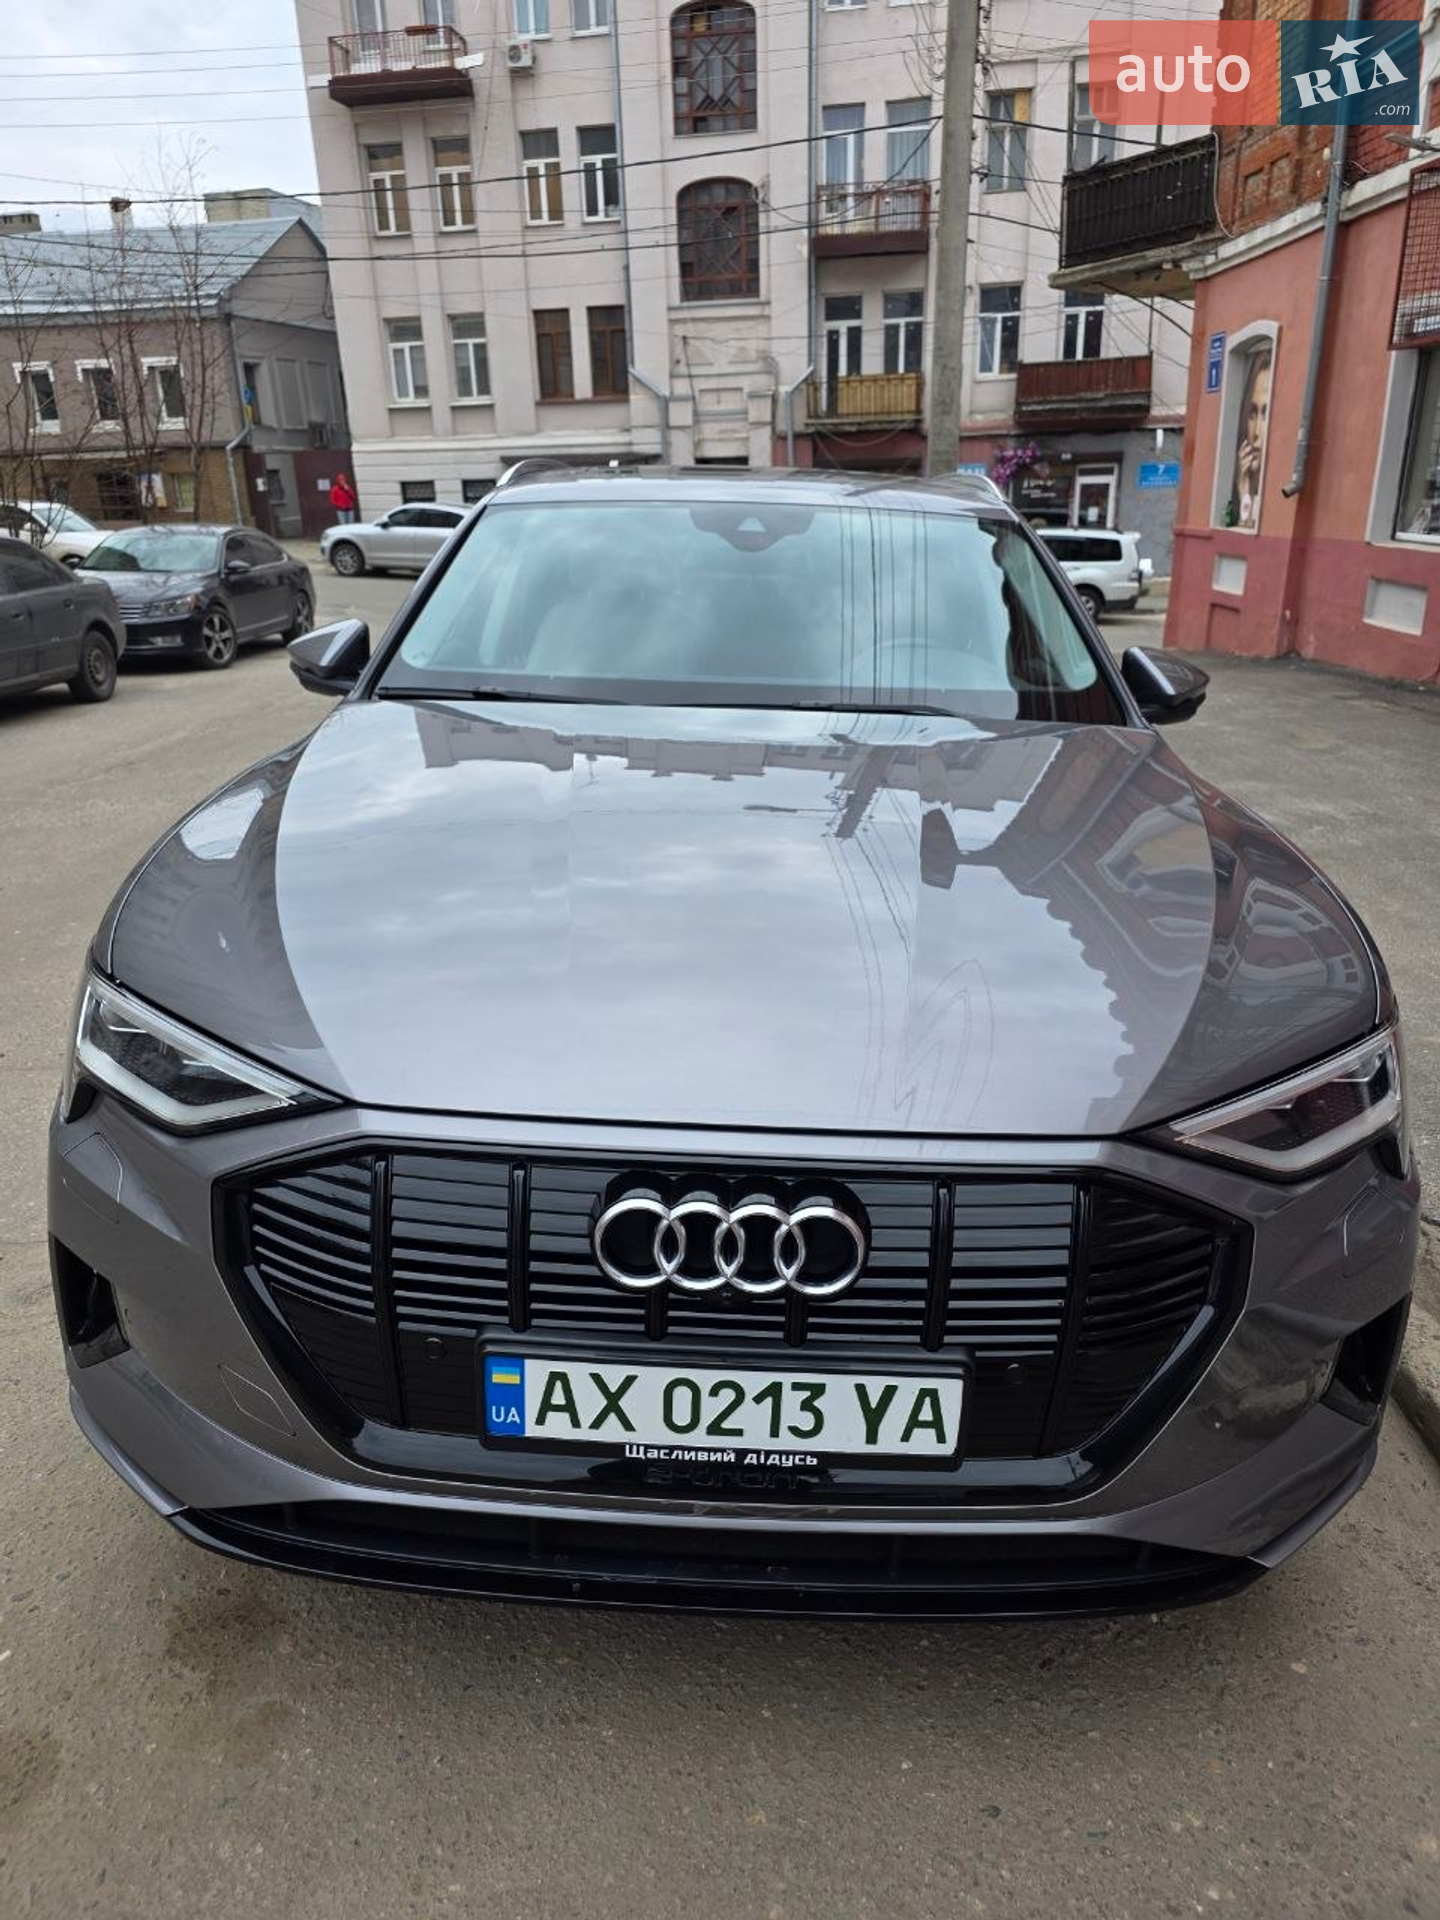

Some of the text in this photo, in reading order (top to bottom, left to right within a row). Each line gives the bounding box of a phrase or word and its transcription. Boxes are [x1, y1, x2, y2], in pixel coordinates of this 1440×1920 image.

[1158, 464, 1165, 476] 7
[491, 1405, 520, 1424] UA
[534, 1370, 947, 1445] AX 0213 YA
[625, 1444, 818, 1467] Щасливий дідусь
